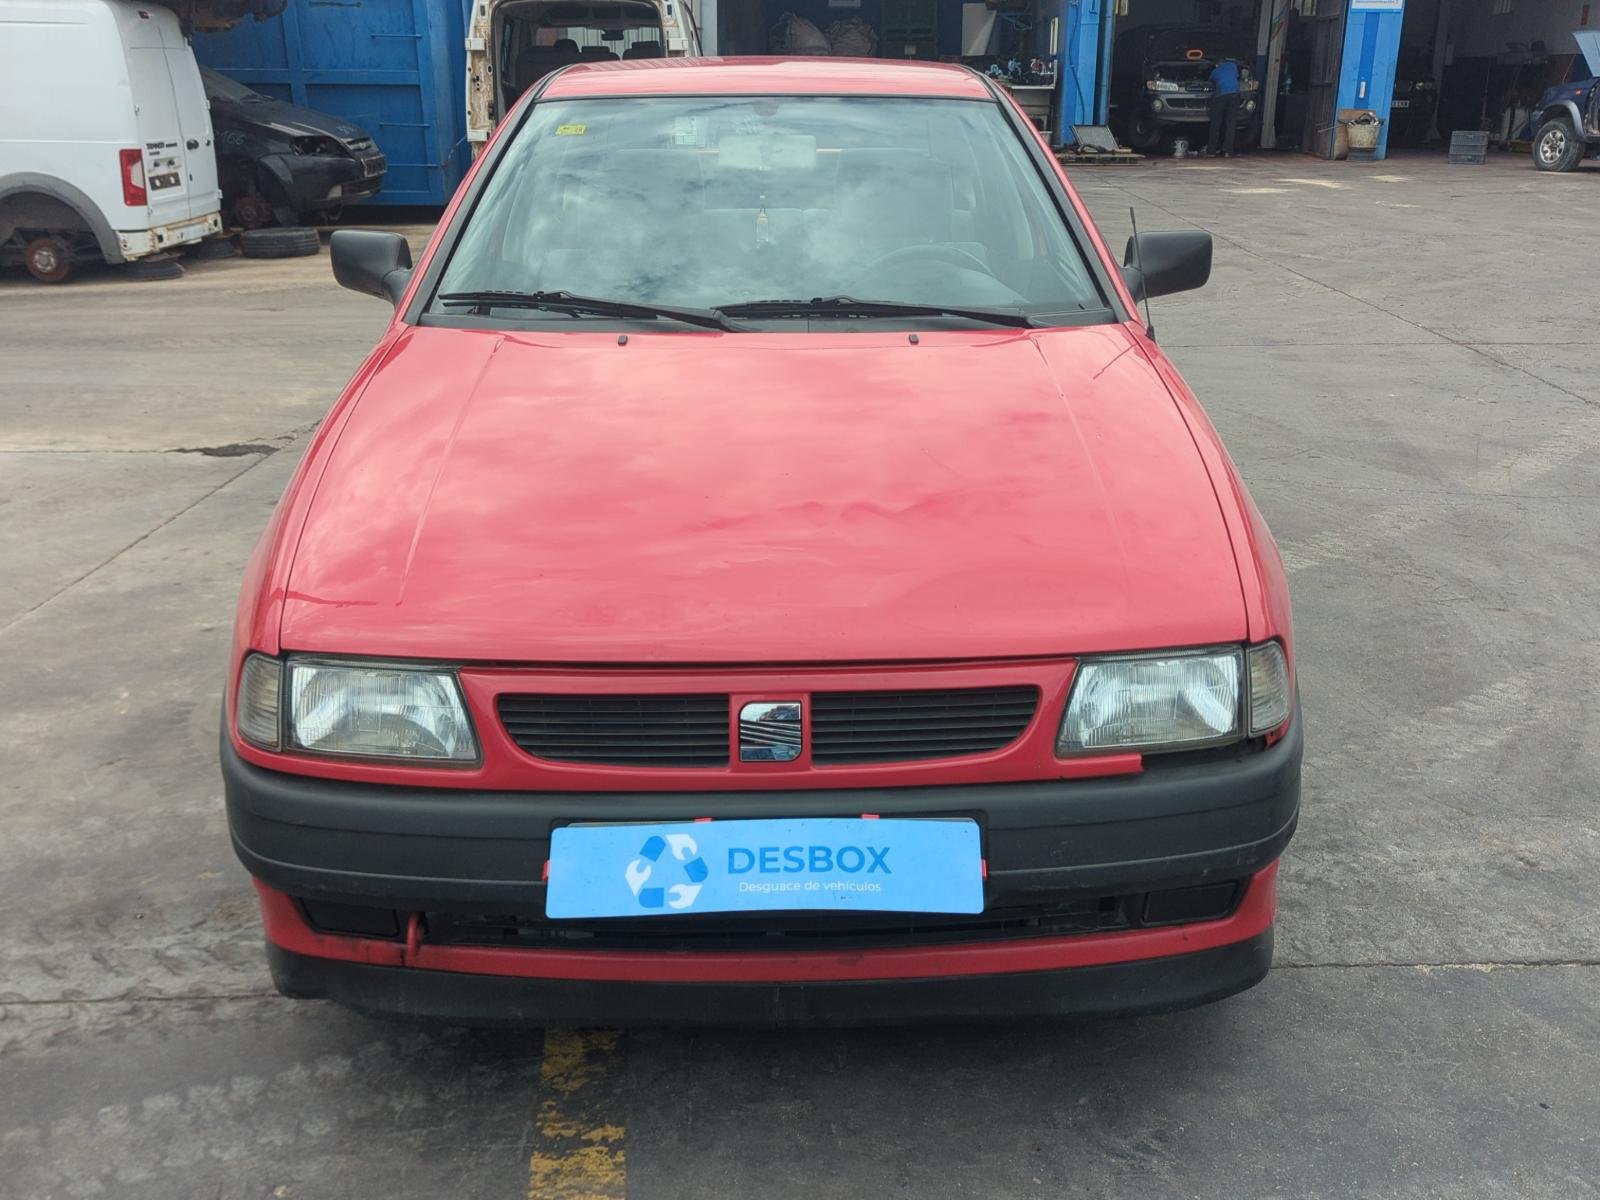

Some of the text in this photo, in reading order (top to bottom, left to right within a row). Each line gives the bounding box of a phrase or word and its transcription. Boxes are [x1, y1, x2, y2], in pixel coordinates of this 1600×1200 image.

[728, 845, 892, 874] DESBOX
[739, 880, 882, 894] Desguace de vehículos
